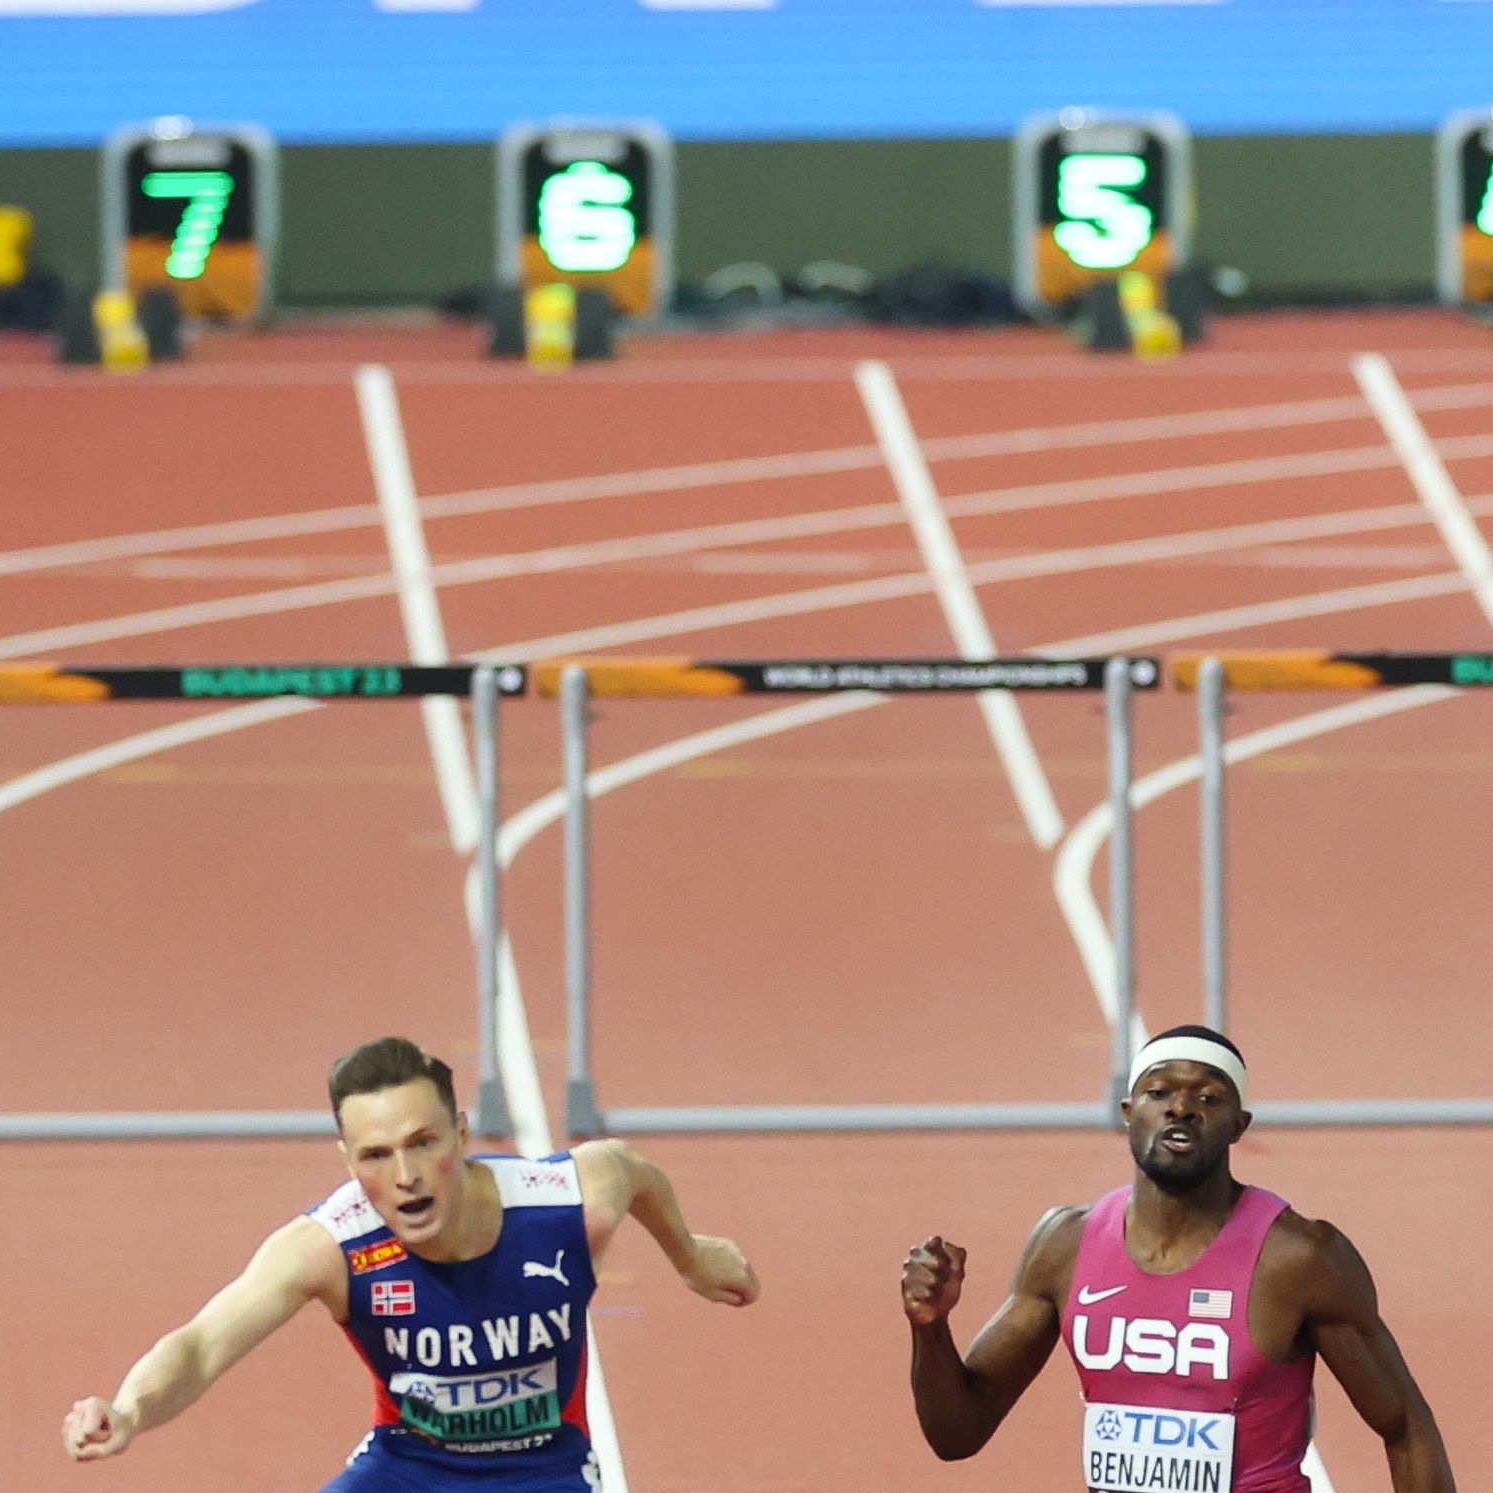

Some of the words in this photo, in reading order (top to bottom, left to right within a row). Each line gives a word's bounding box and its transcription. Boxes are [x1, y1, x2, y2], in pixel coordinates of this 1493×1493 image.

[142, 170, 233, 279] 7
[538, 161, 635, 272] 6
[1053, 151, 1151, 270] 5
[384, 1303, 571, 1367] NORWAY
[1072, 1315, 1230, 1380] USA
[435, 1368, 542, 1407] TDK
[1125, 1412, 1221, 1450] TDK
[1091, 1450, 1221, 1493] BENJAMIN
